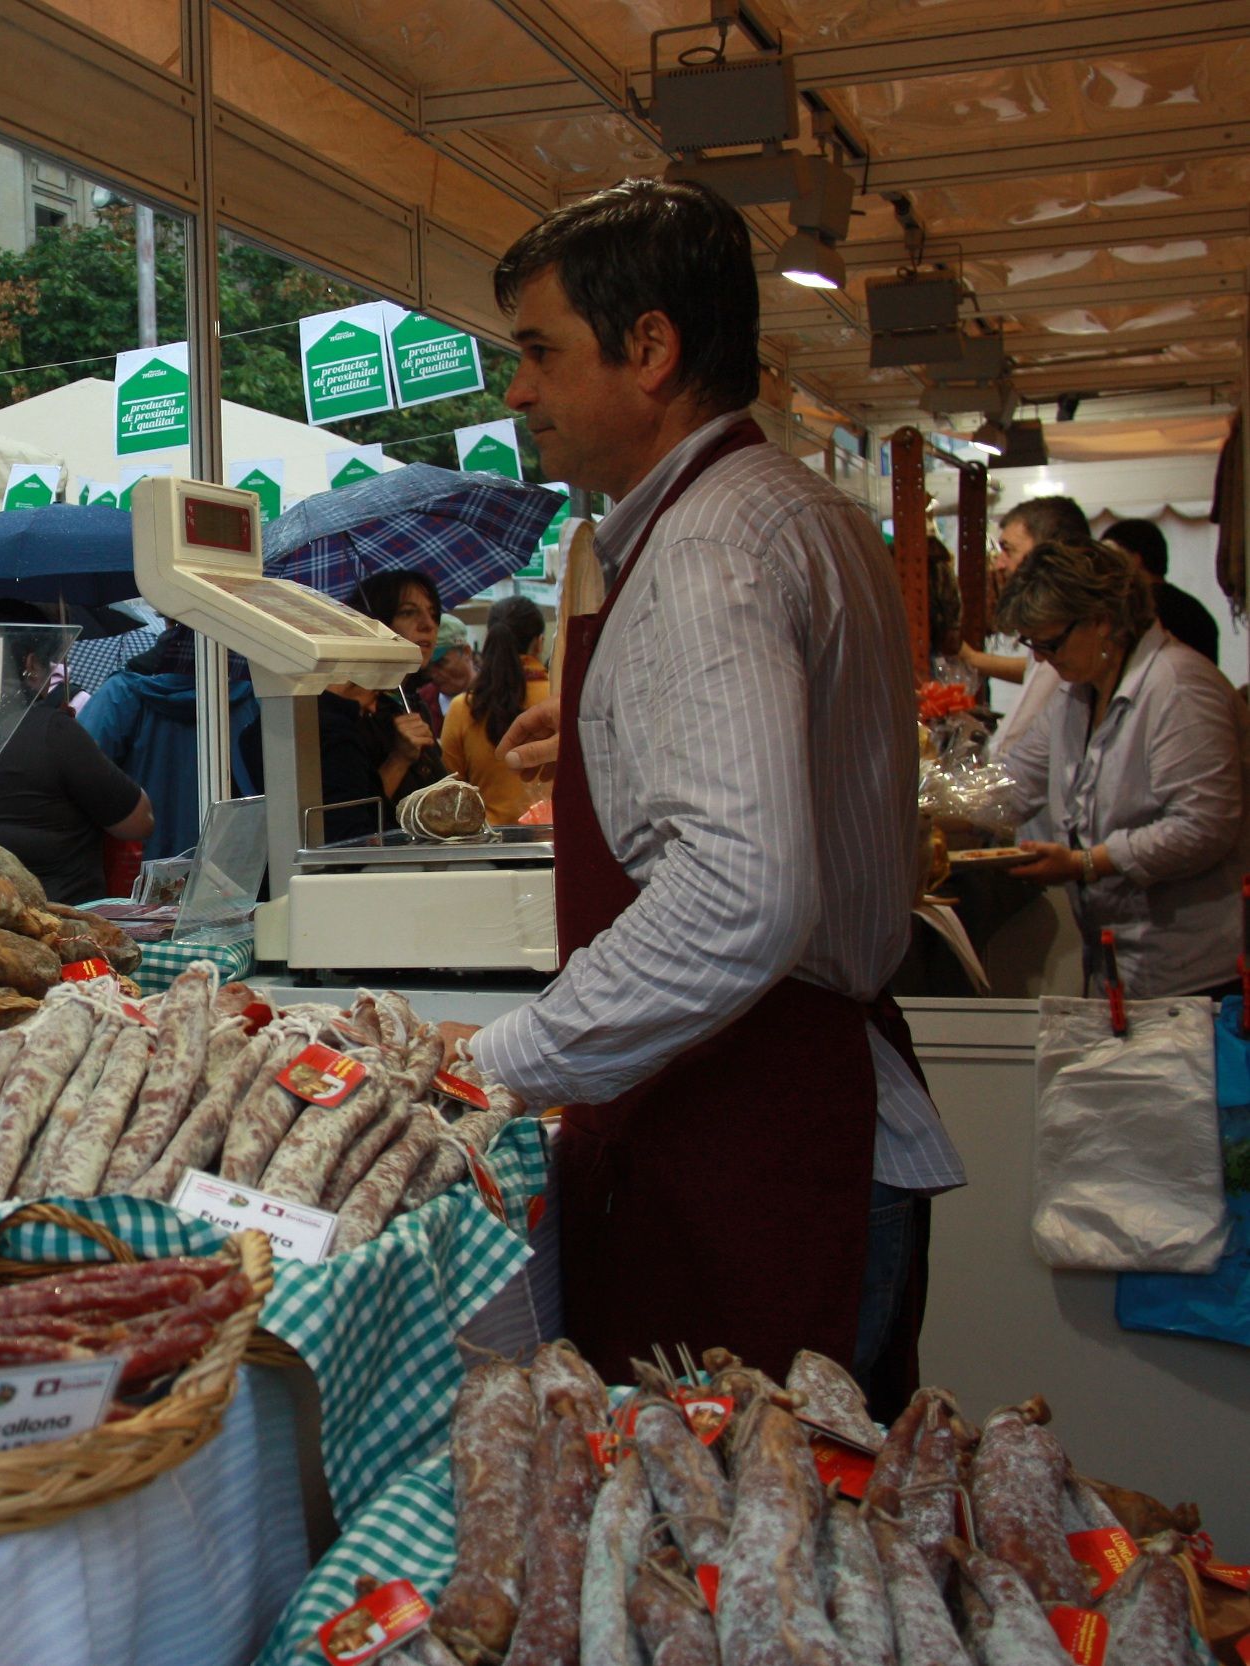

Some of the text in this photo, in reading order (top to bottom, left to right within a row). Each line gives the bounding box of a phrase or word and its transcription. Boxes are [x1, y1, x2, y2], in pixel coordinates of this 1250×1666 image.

[402, 347, 467, 369] de proximitat
[409, 340, 457, 359] productes
[313, 366, 378, 387] de proximitat
[321, 359, 369, 378] productes
[411, 359, 460, 378] i qualitat
[322, 378, 370, 395] i qualitat
[122, 406, 184, 423] de proximitat
[131, 399, 176, 413] productes
[129, 417, 175, 432] i qualitat
[200, 1210, 240, 1230] Fuet
